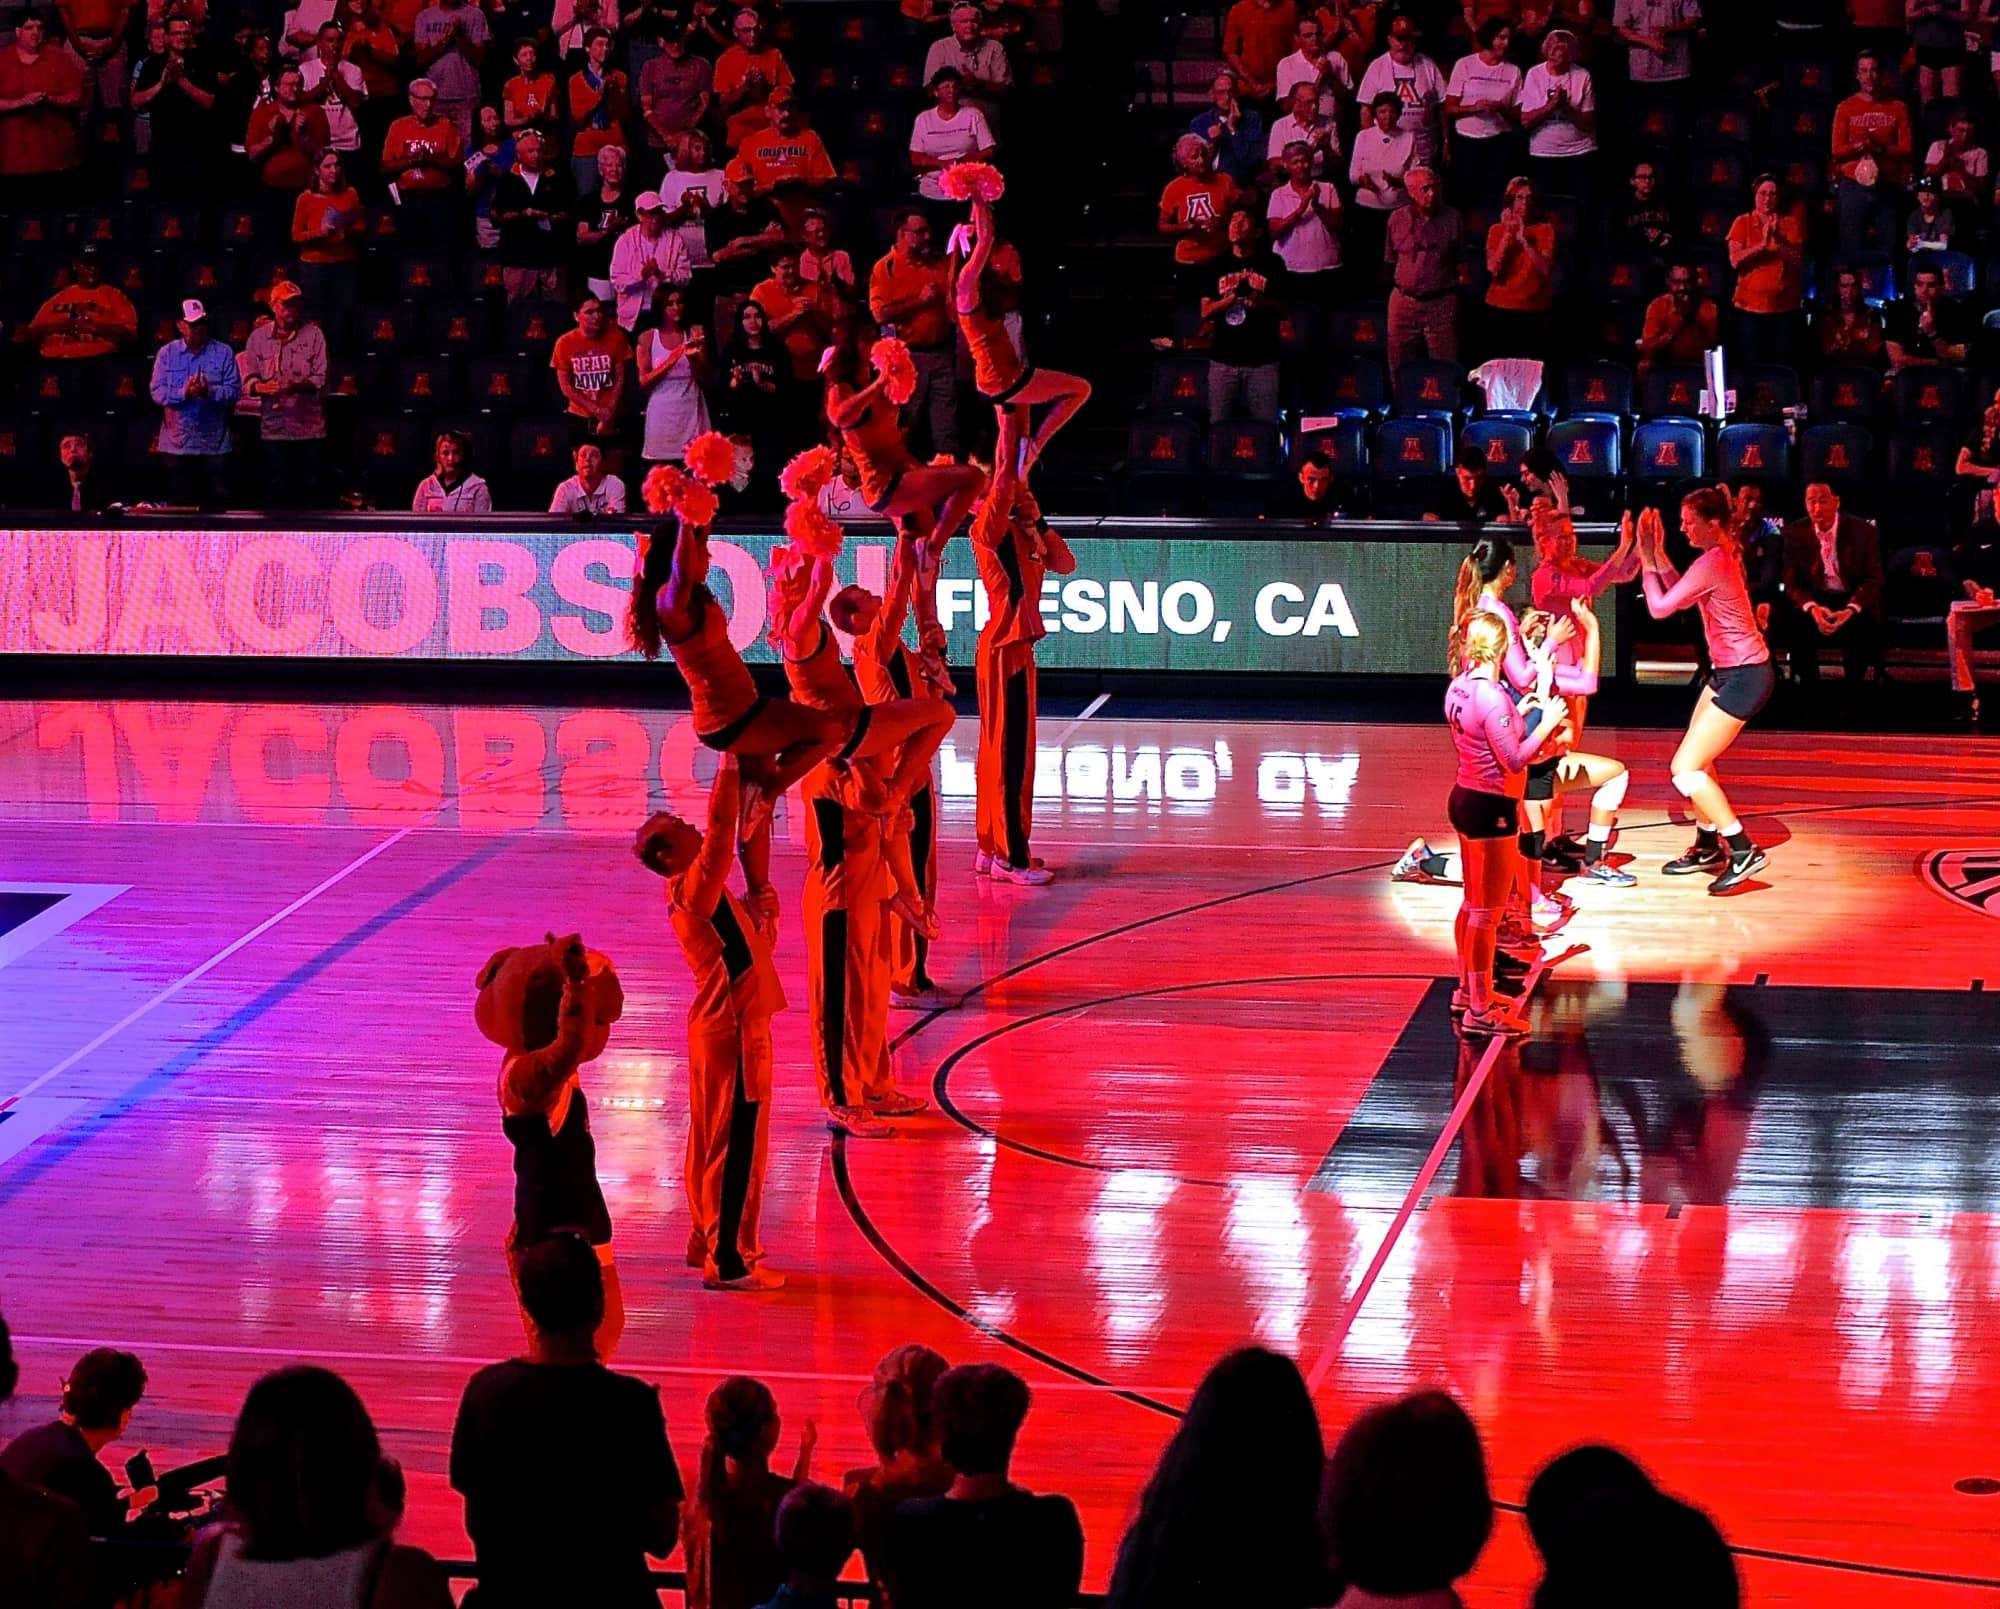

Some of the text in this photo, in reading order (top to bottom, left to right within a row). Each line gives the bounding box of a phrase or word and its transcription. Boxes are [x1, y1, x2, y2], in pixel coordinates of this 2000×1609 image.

[571, 355, 612, 372] BEAR
[1254, 580, 1360, 638] CA
[1449, 702, 1466, 735] 15
